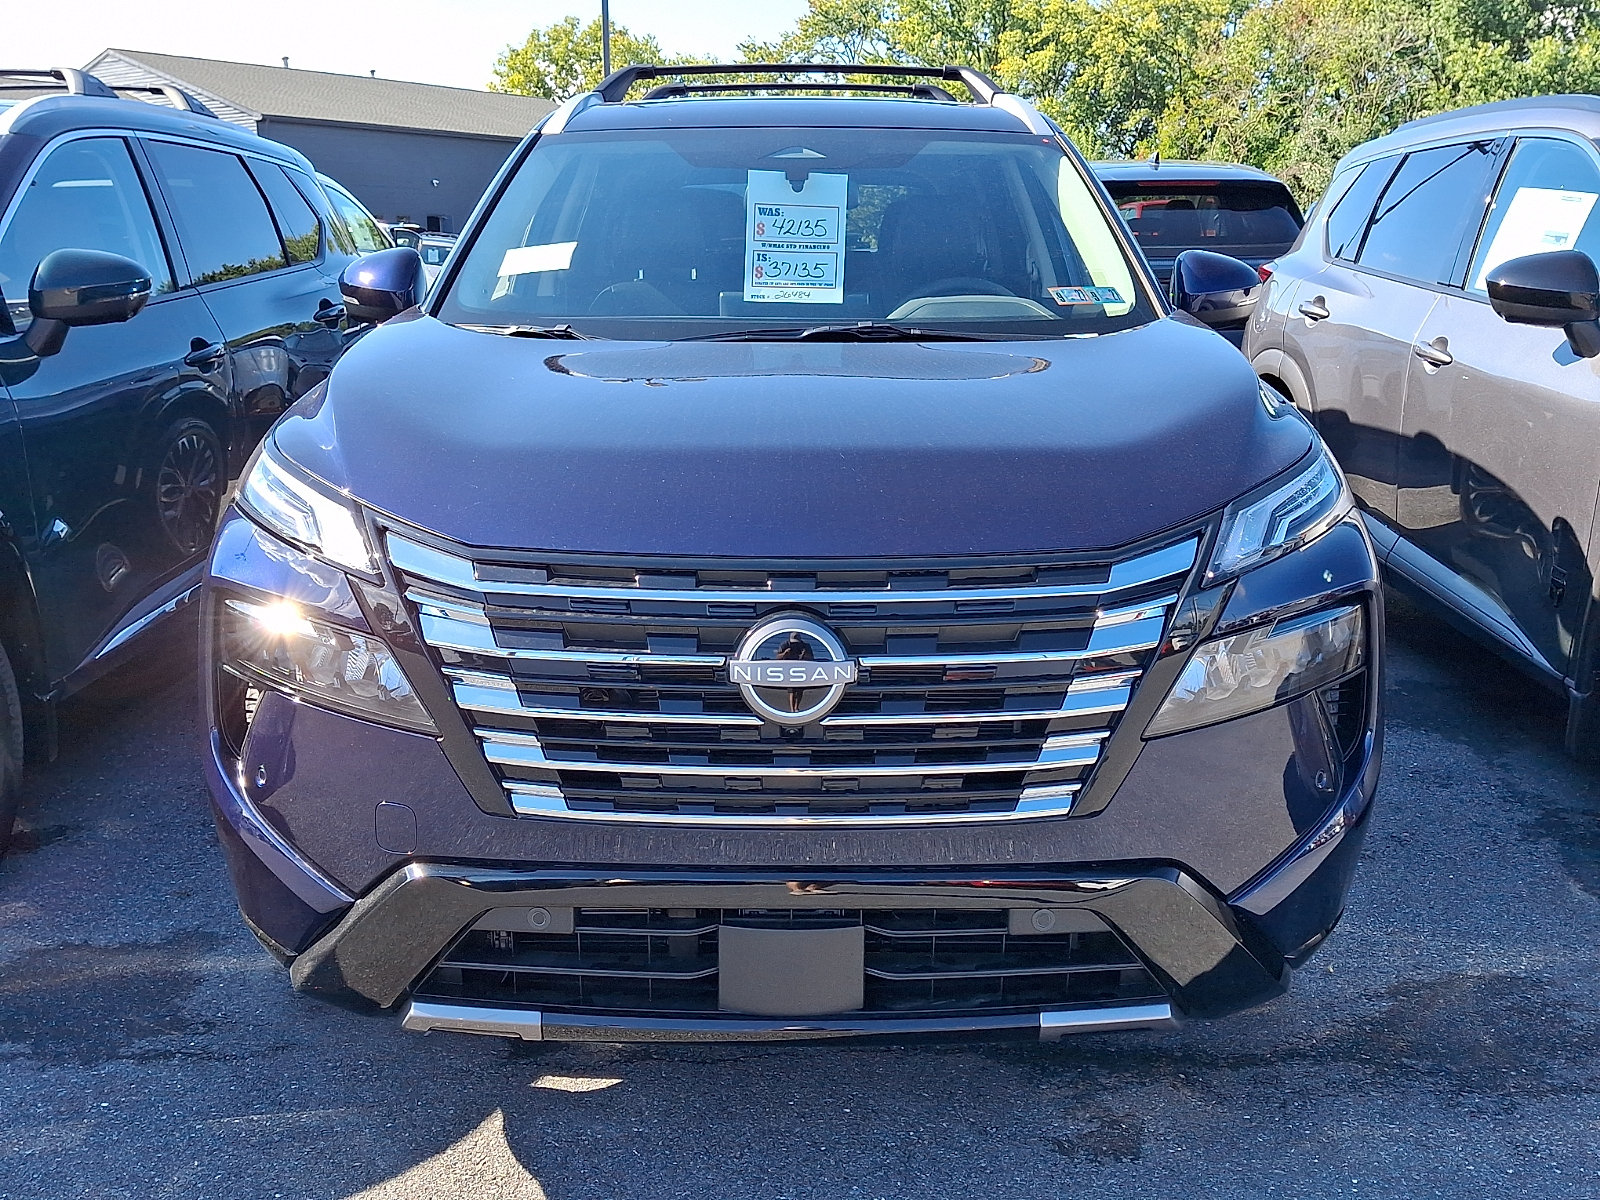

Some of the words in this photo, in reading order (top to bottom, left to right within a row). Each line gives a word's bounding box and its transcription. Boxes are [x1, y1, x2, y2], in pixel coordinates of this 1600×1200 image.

[757, 207, 784, 217] WAS:
[756, 221, 765, 237] $
[772, 218, 827, 237] 42135
[756, 253, 772, 262] IS:
[754, 264, 764, 280] $
[765, 261, 829, 278] 37135
[1056, 292, 1066, 302] 9
[1090, 291, 1100, 302] 9
[734, 665, 851, 682] NISSAN
